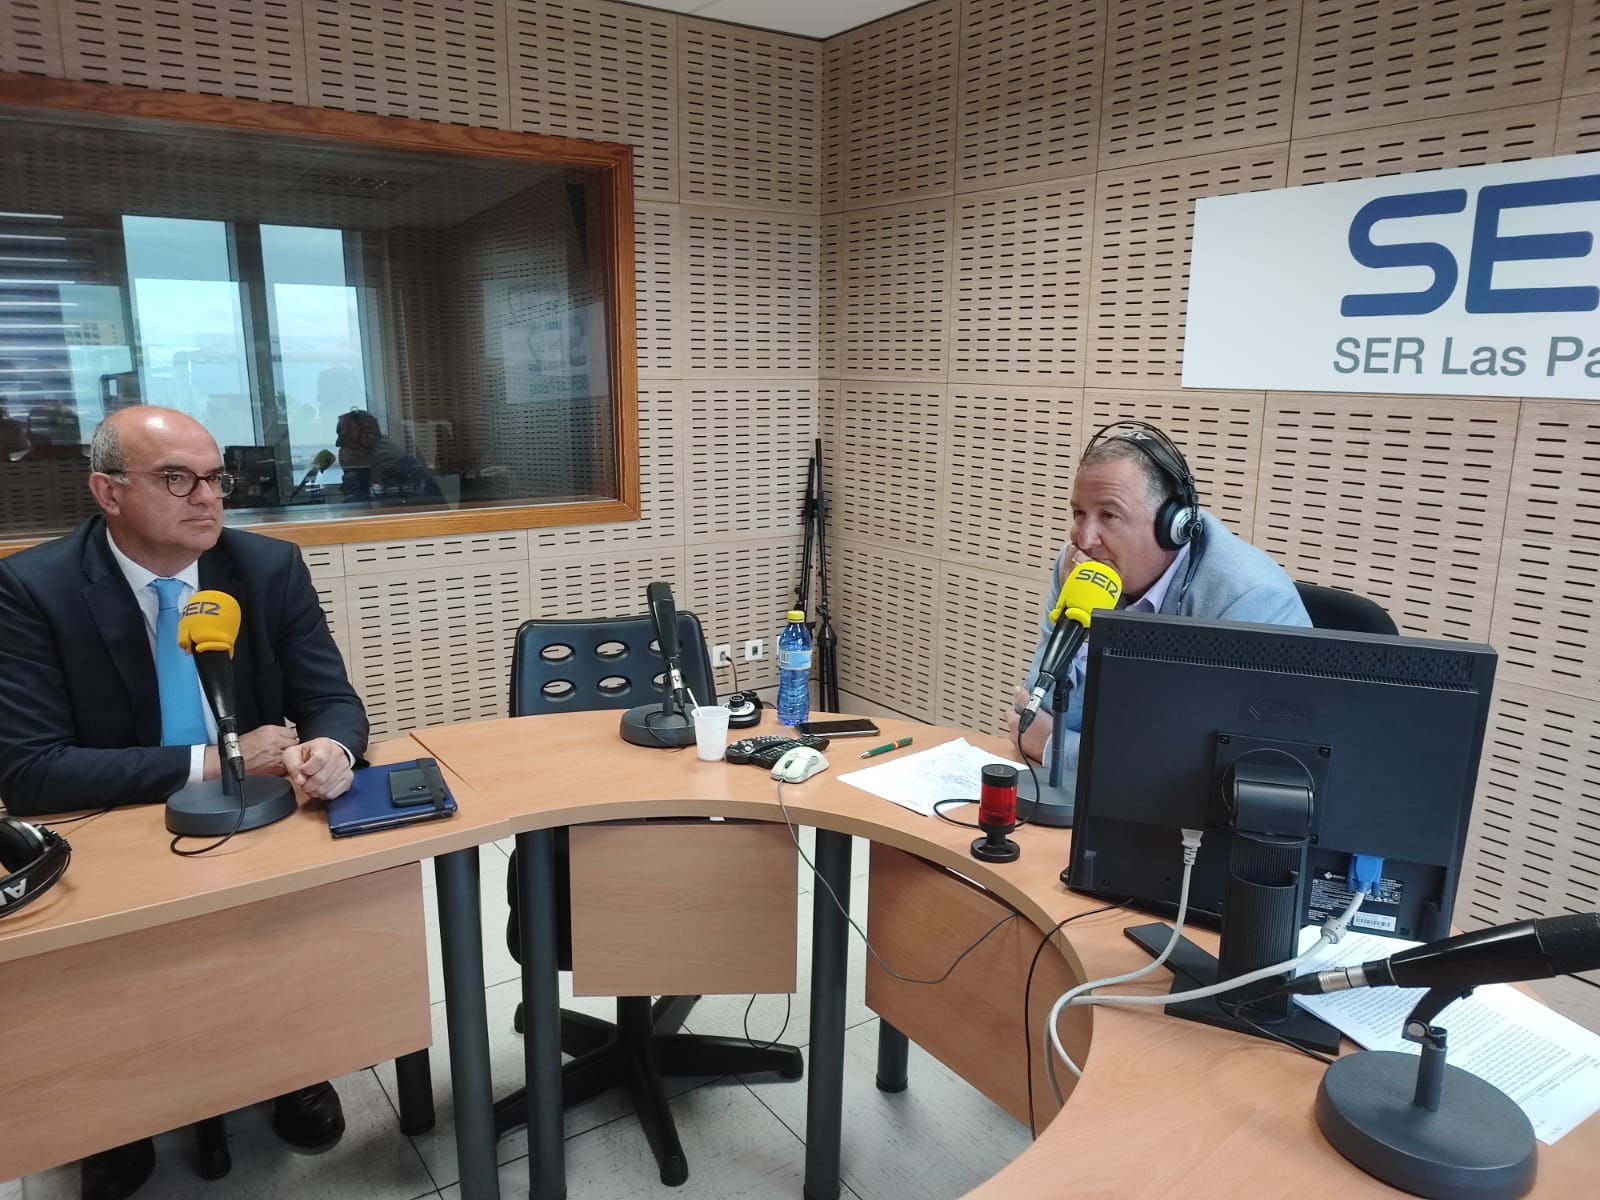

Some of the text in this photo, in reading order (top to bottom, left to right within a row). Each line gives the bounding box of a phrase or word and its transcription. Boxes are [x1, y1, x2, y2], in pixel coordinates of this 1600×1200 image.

[1334, 337, 1426, 374] SER
[1442, 337, 1527, 376] Las
[1075, 569, 1119, 599] SER
